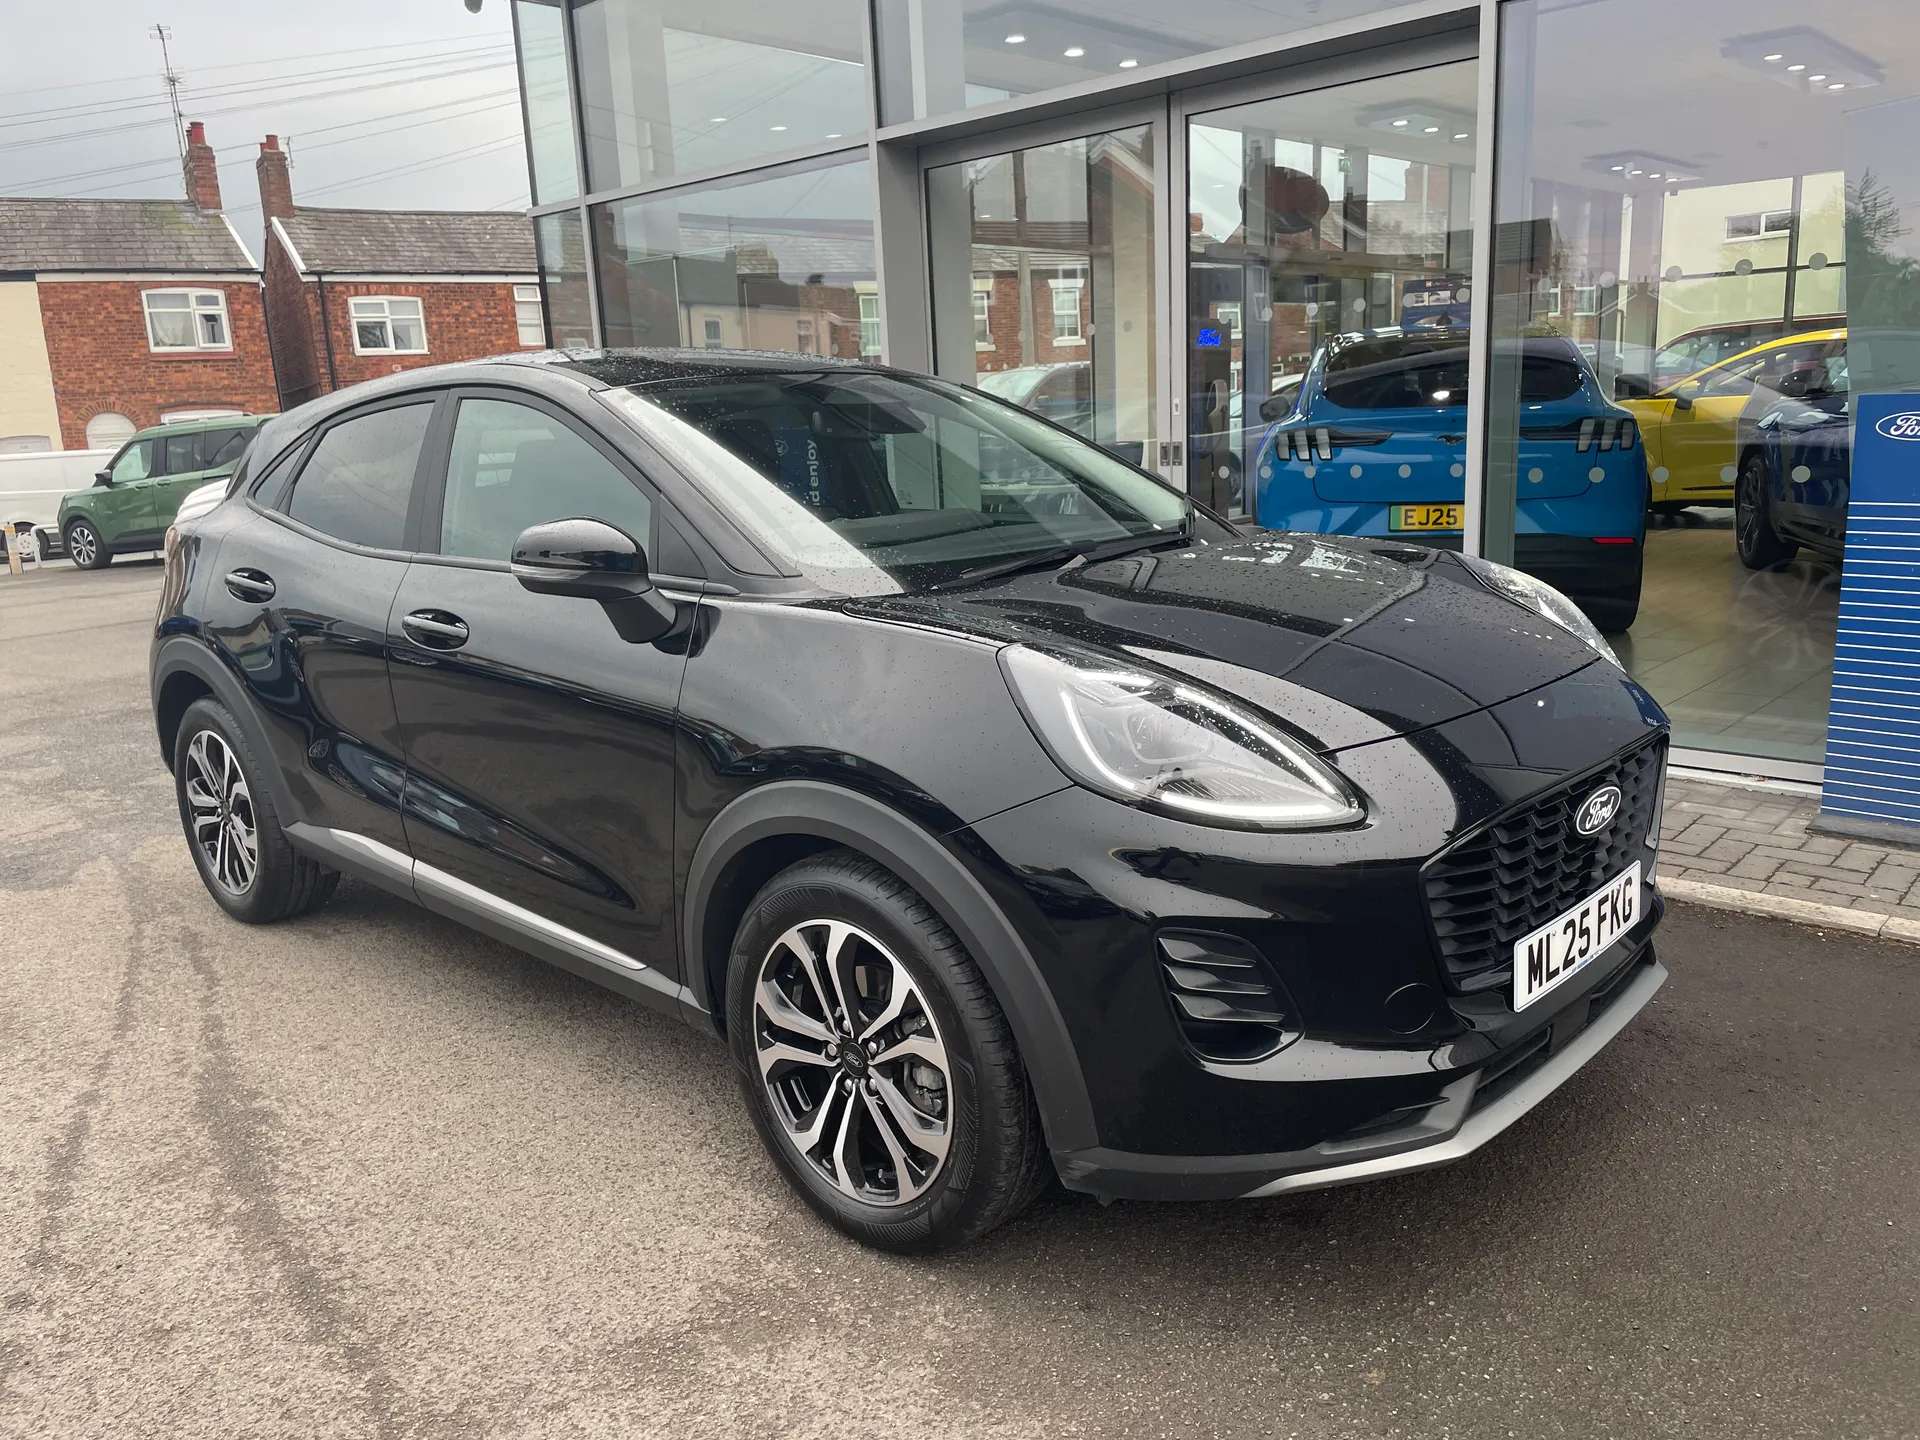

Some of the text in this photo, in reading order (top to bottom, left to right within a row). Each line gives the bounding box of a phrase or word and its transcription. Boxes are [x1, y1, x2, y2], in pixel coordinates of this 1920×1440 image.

[1889, 415, 1920, 436] Fo
[807, 439, 819, 487] enjoy
[1403, 508, 1458, 527] EJ25
[1585, 793, 1615, 830] Ford
[1527, 876, 1633, 995] ML25 FKG
